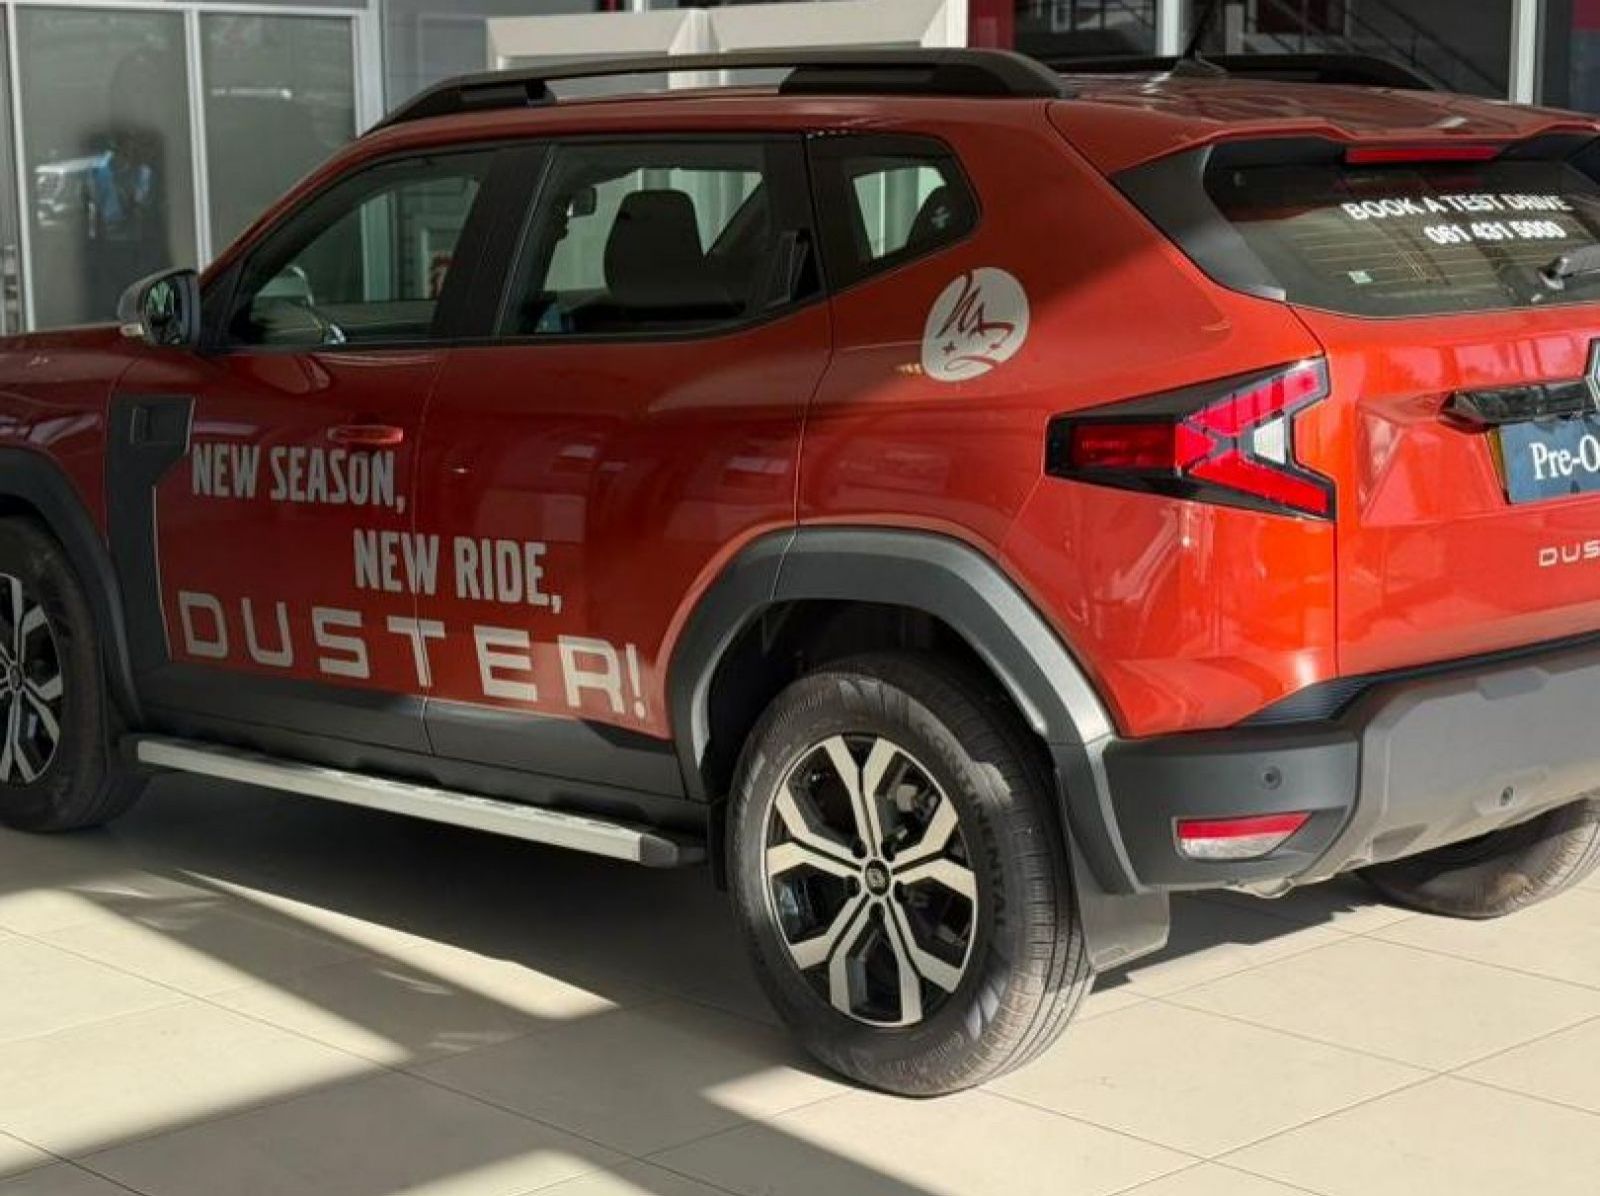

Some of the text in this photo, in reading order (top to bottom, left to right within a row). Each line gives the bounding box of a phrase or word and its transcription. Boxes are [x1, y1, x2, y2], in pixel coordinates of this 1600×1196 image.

[1341, 194, 1572, 219] BOOK A TEST DRIVE
[191, 442, 407, 514] NEW SEASON,
[1530, 435, 1600, 479] Pre-O
[353, 528, 563, 614] NEW RIDE,
[178, 590, 648, 720] DUSTER!
